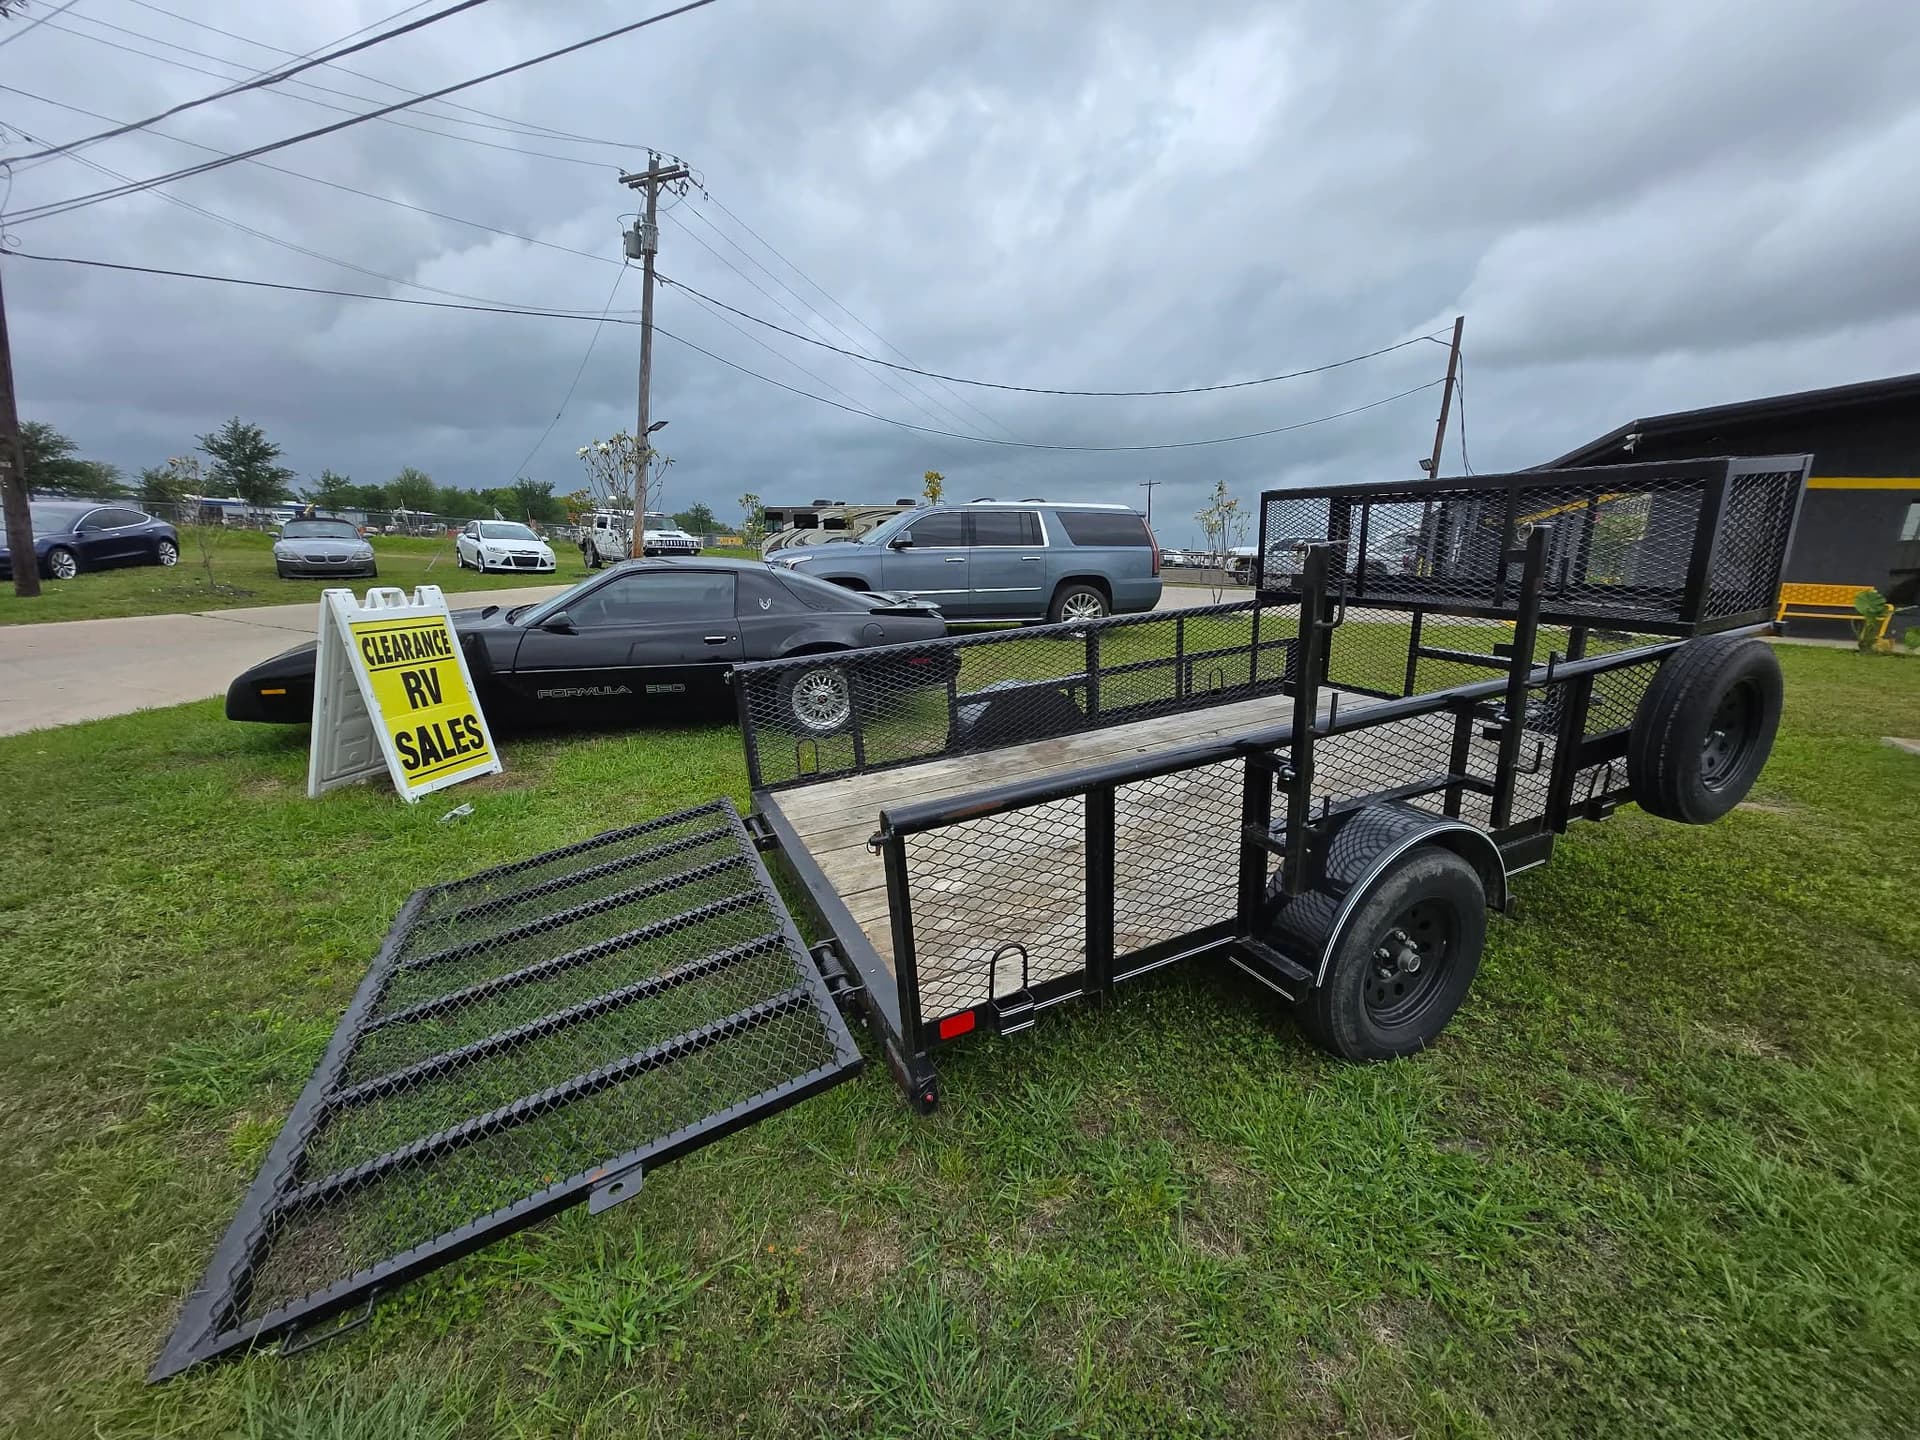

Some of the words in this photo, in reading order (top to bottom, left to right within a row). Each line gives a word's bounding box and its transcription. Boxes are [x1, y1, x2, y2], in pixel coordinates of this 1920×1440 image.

[361, 629, 452, 666] CLEARANCE
[400, 667, 443, 710] RV
[537, 685, 633, 699] FORMULA
[395, 714, 485, 770] SALES
